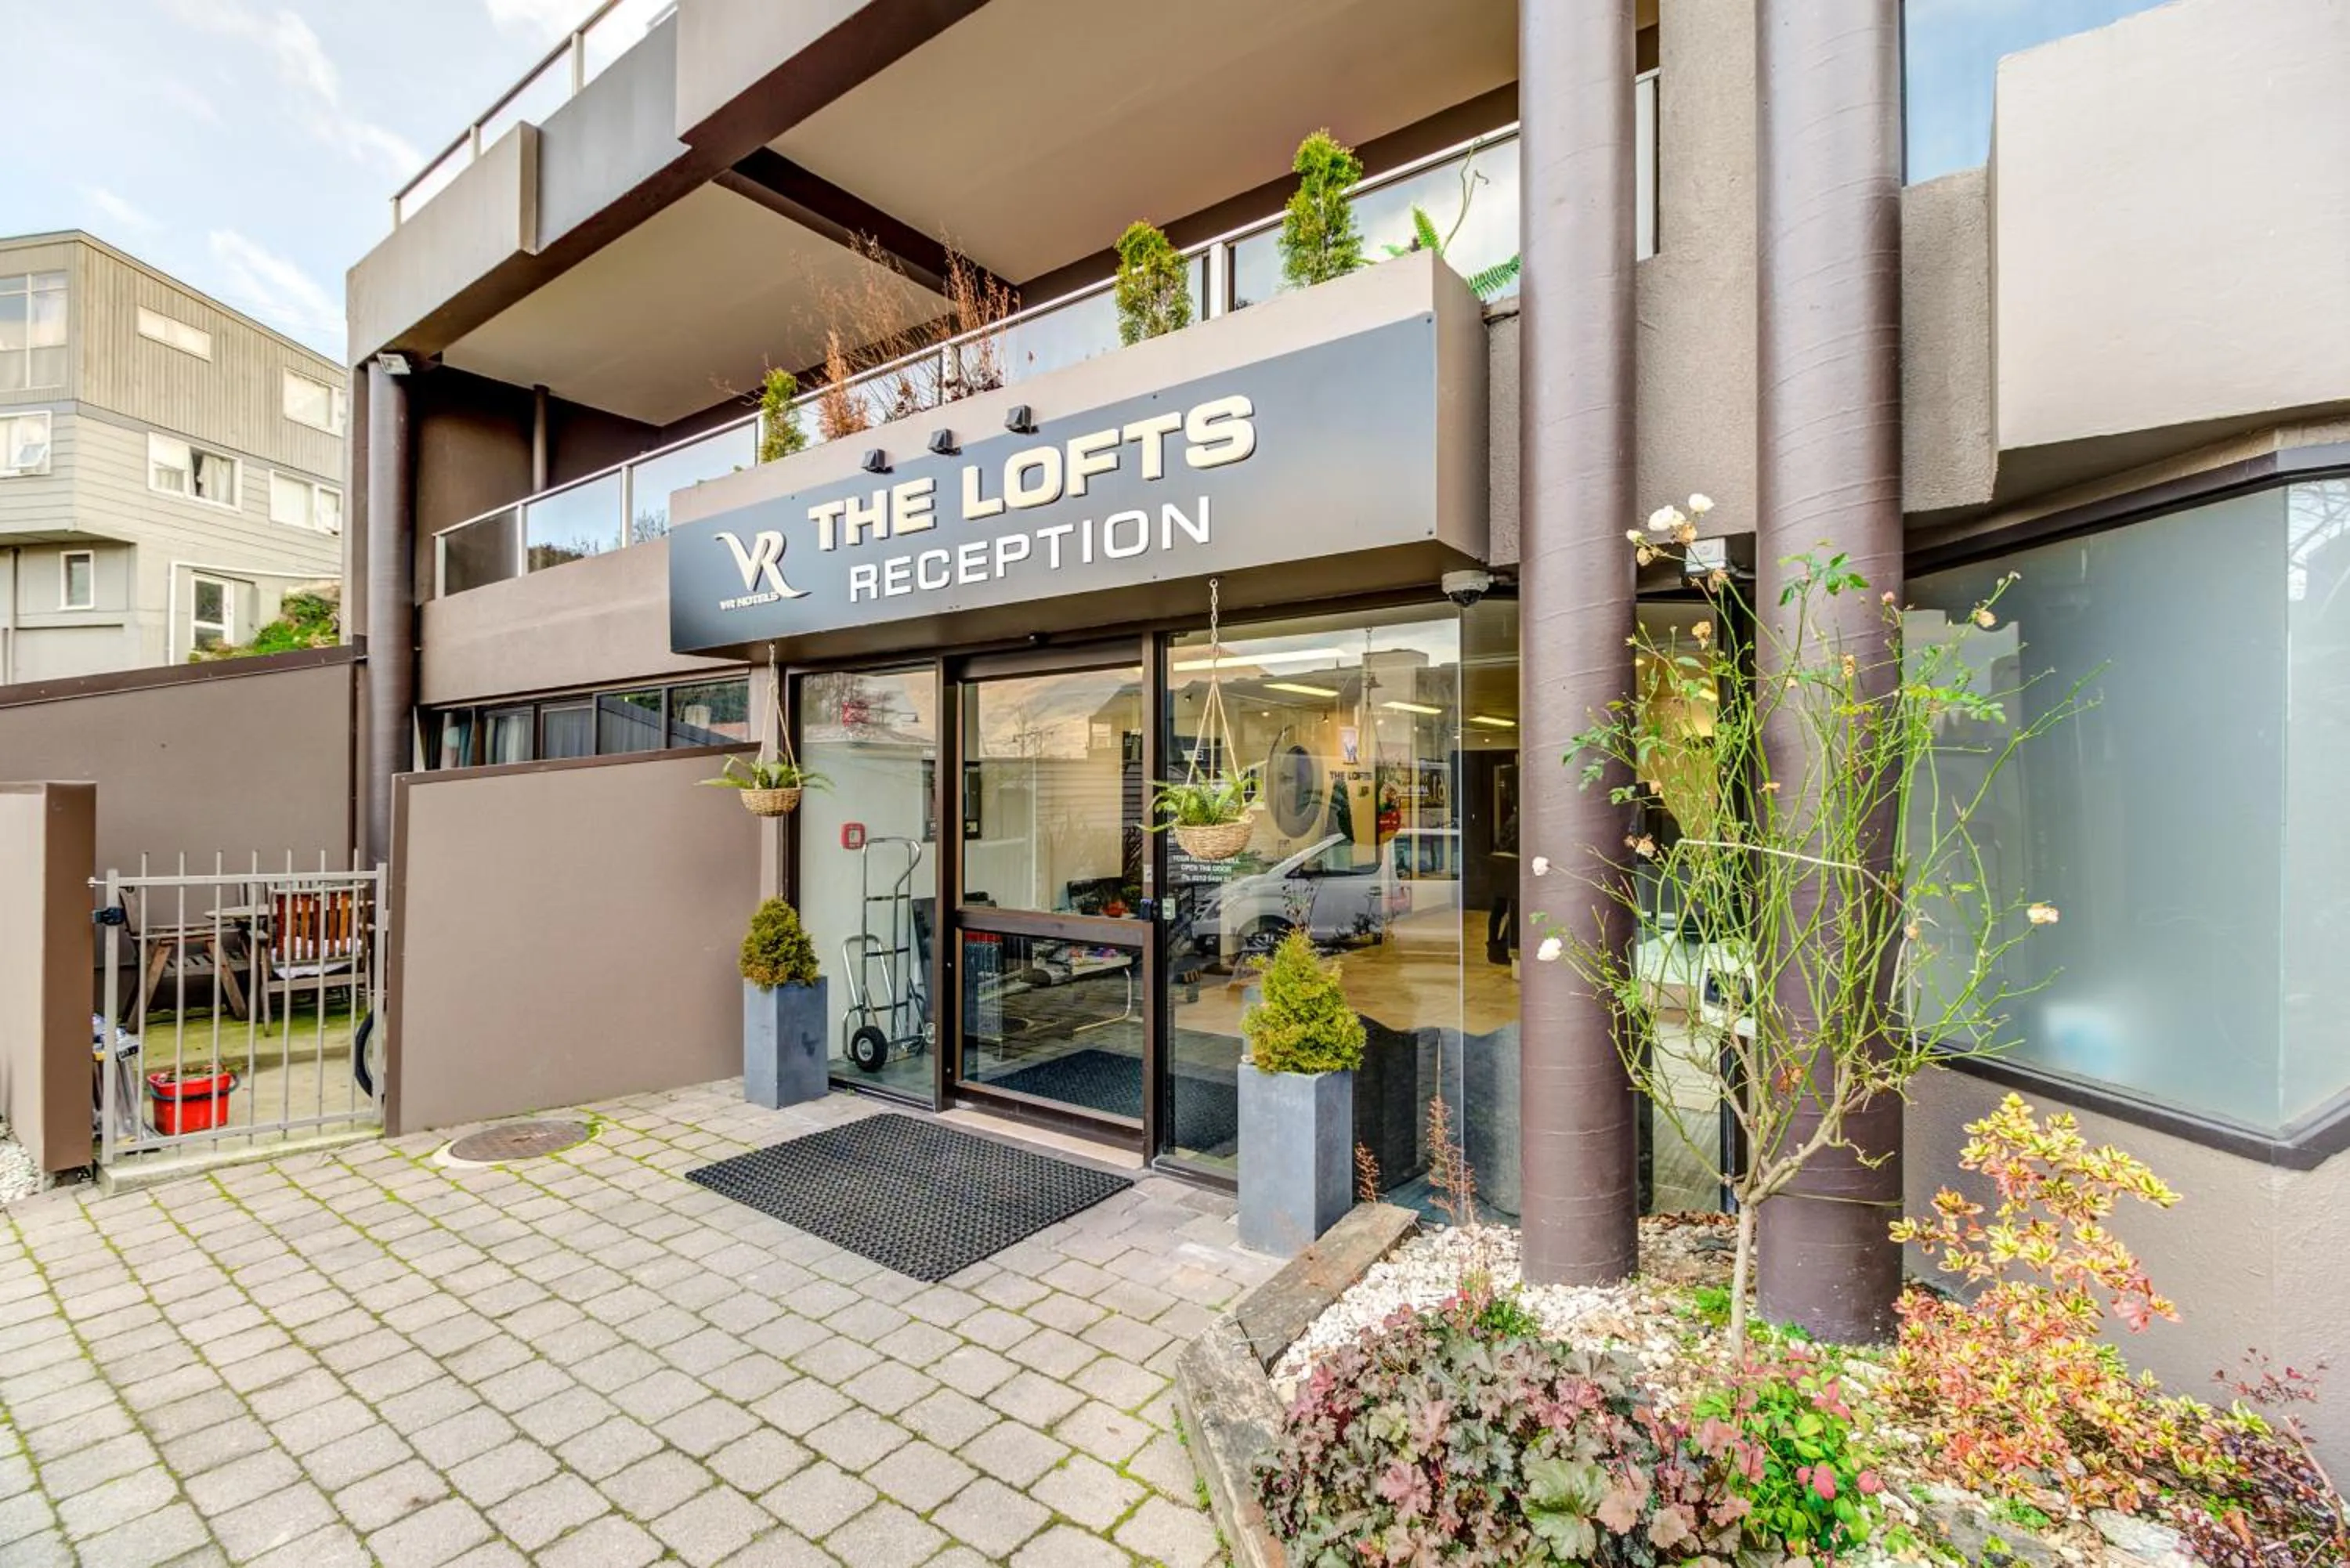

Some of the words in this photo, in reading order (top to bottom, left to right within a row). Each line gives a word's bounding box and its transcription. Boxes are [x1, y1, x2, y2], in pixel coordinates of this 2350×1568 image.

[808, 477, 936, 551] THE
[962, 395, 1256, 520] LOFTS
[714, 530, 812, 598] VR
[850, 496, 1210, 603] RECEPTION
[736, 592, 781, 609] HOTELS
